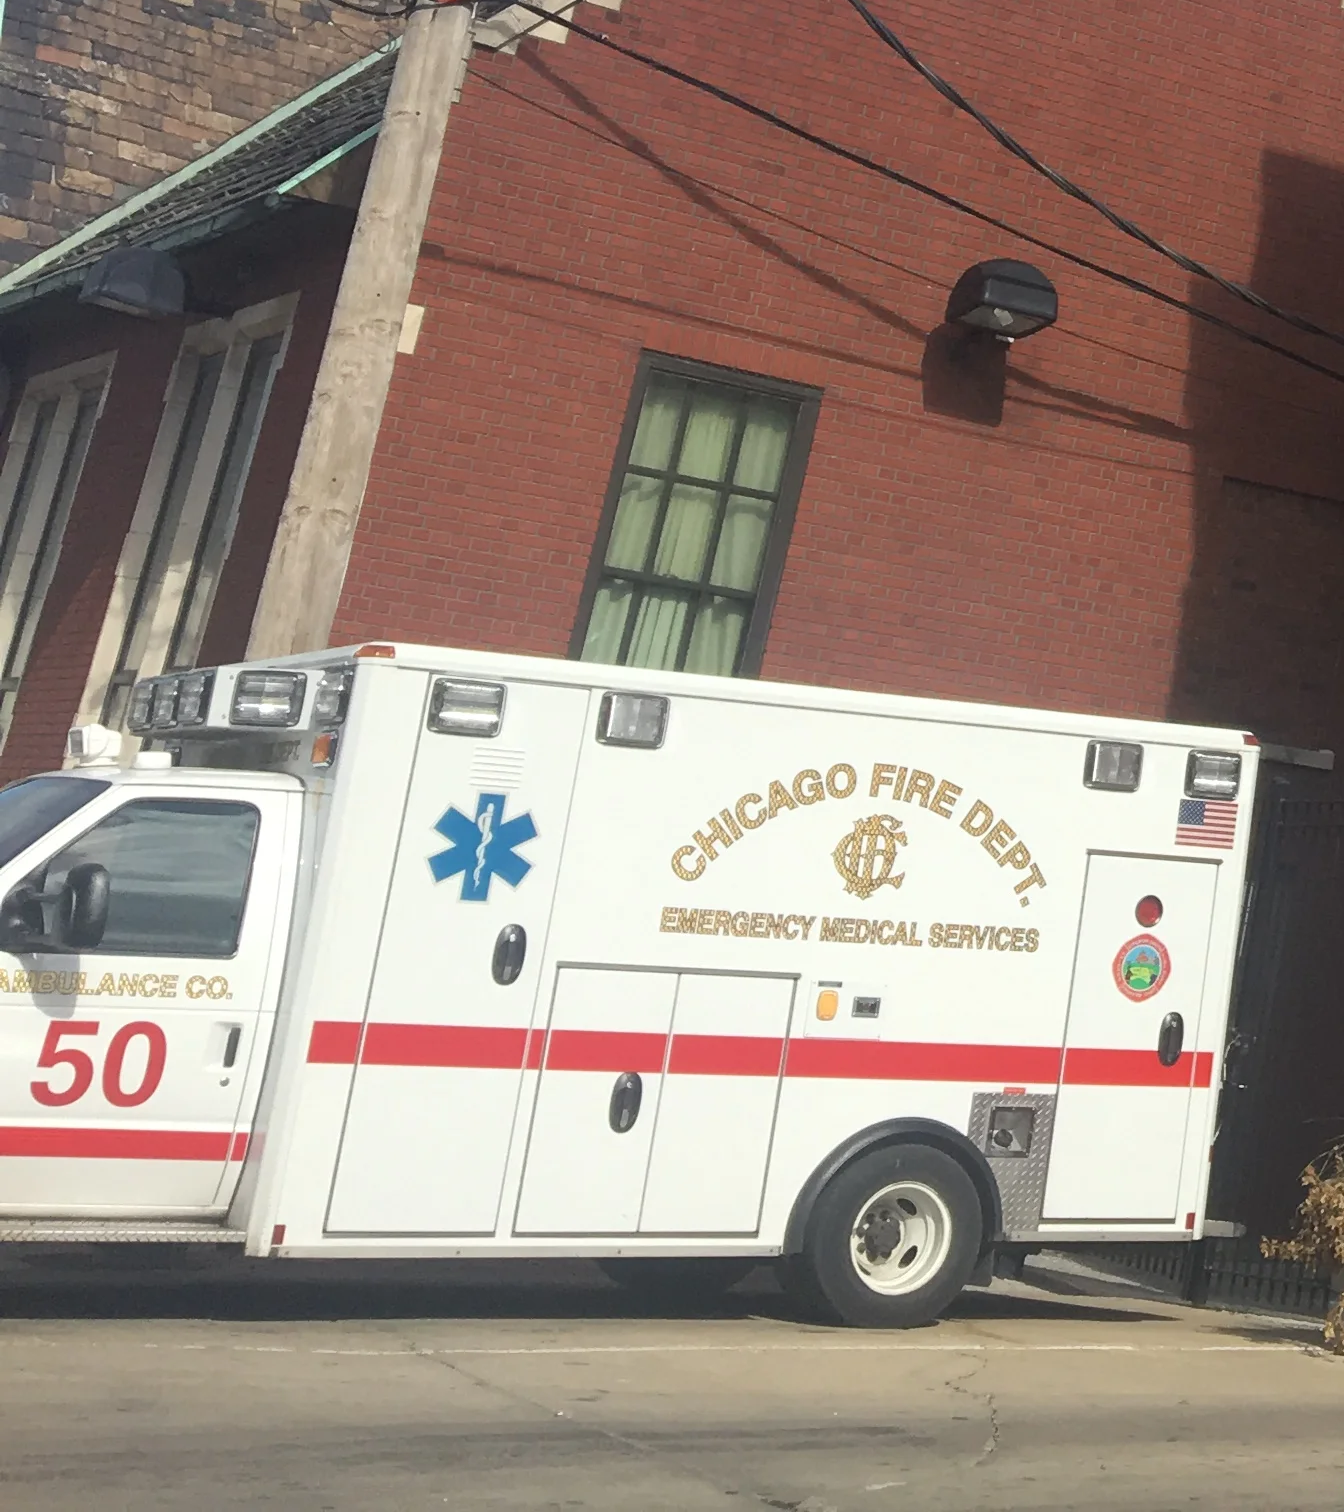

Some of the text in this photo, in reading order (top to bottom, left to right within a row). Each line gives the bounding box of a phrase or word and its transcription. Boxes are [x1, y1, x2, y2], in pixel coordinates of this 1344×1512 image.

[671, 762, 1047, 908] CHICAGO FIRE DEPT.
[659, 906, 1040, 953] EMERGENCY MEDICAL SERVICES
[0, 968, 234, 1001] AMBULANCE CO.
[30, 1020, 167, 1108] 50
